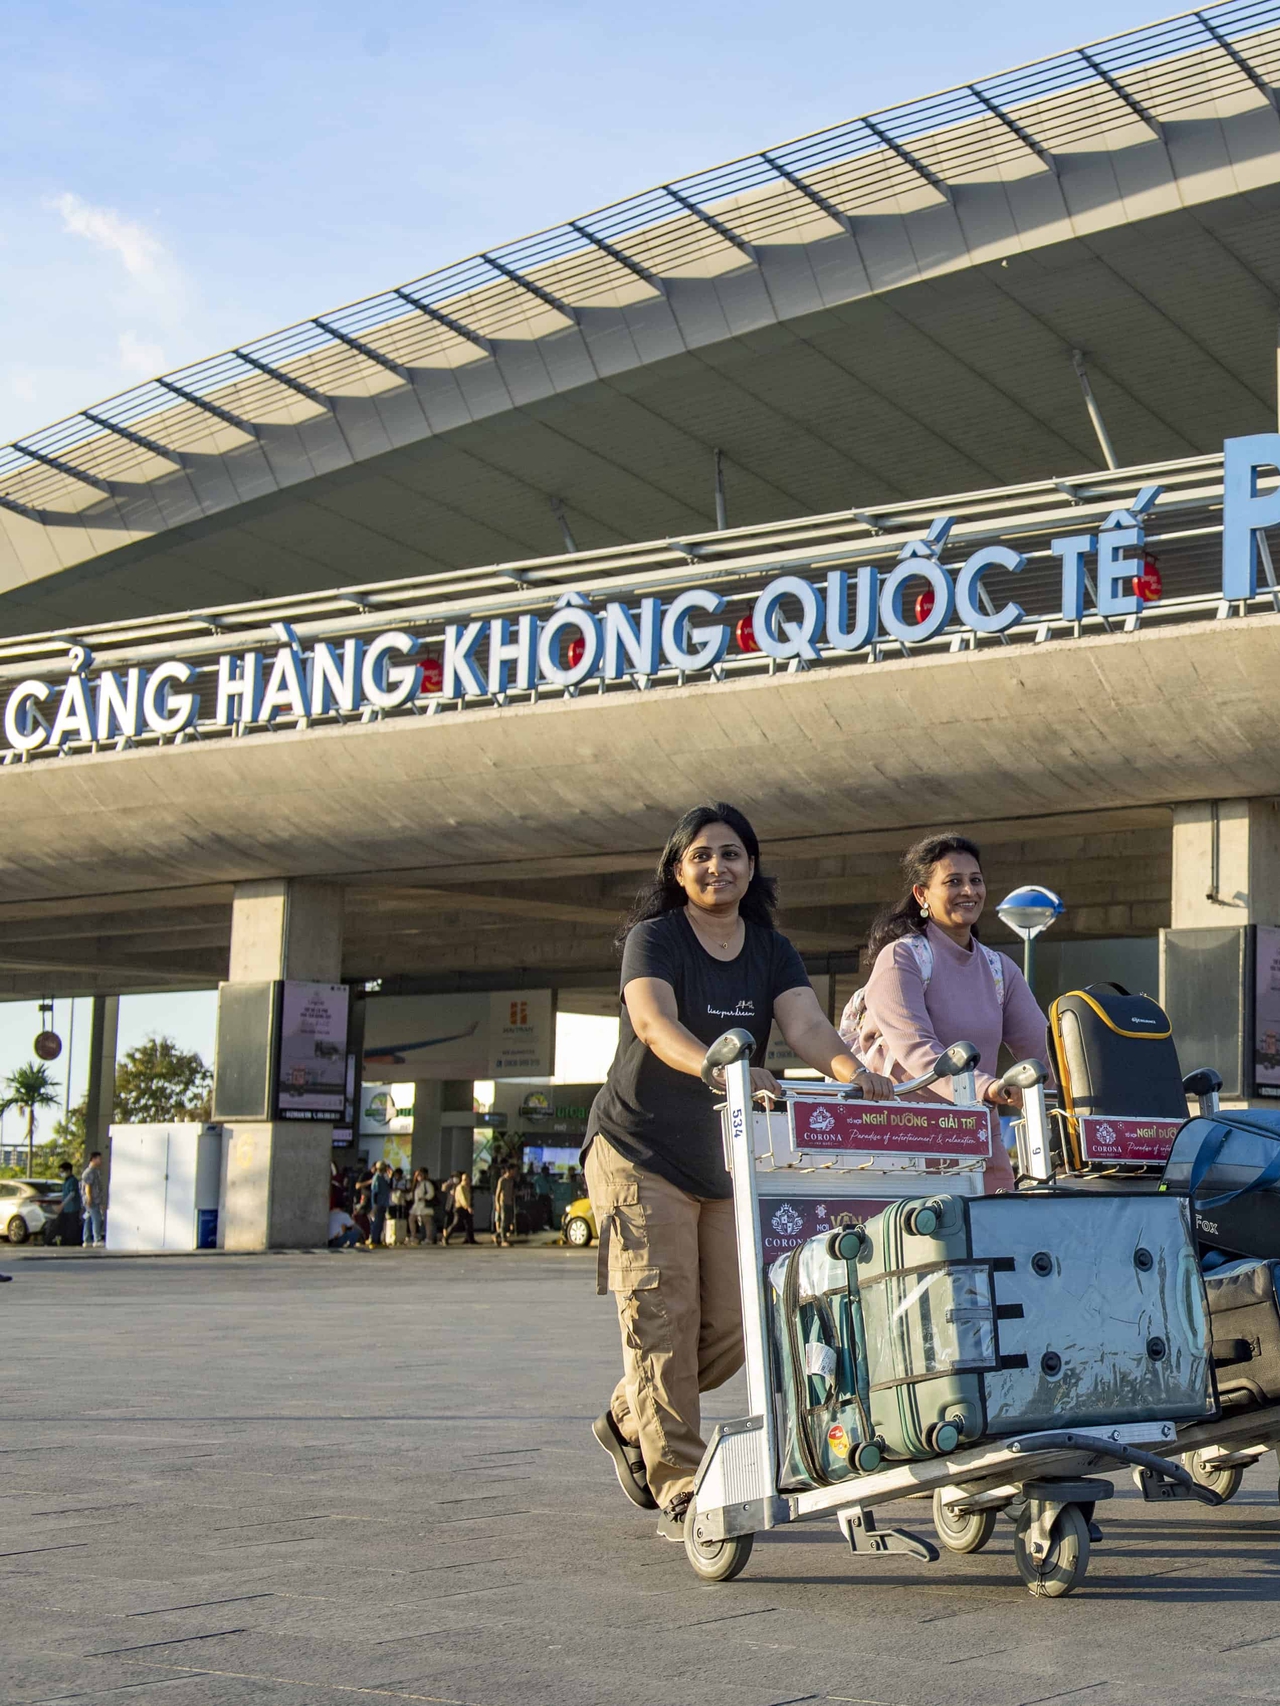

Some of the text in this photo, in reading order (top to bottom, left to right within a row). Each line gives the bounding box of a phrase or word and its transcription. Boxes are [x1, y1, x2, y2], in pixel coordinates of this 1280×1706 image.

[4, 646, 200, 751] CẢNG
[217, 622, 423, 726] HÀNG
[443, 591, 731, 700] KHÔNG
[752, 516, 1028, 660] QUỐC
[1051, 485, 1165, 621] TẾ
[732, 1108, 743, 1139] 534
[804, 1132, 843, 1141] CORONA
[849, 1129, 882, 1141] Paradise
[883, 1133, 892, 1144] of
[892, 1133, 934, 1143] entertainment
[945, 1134, 976, 1146] relaxation
[1158, 1126, 1177, 1139] DƯỠ
[1092, 1145, 1122, 1153] CORONA
[765, 1237, 809, 1248] CORON
